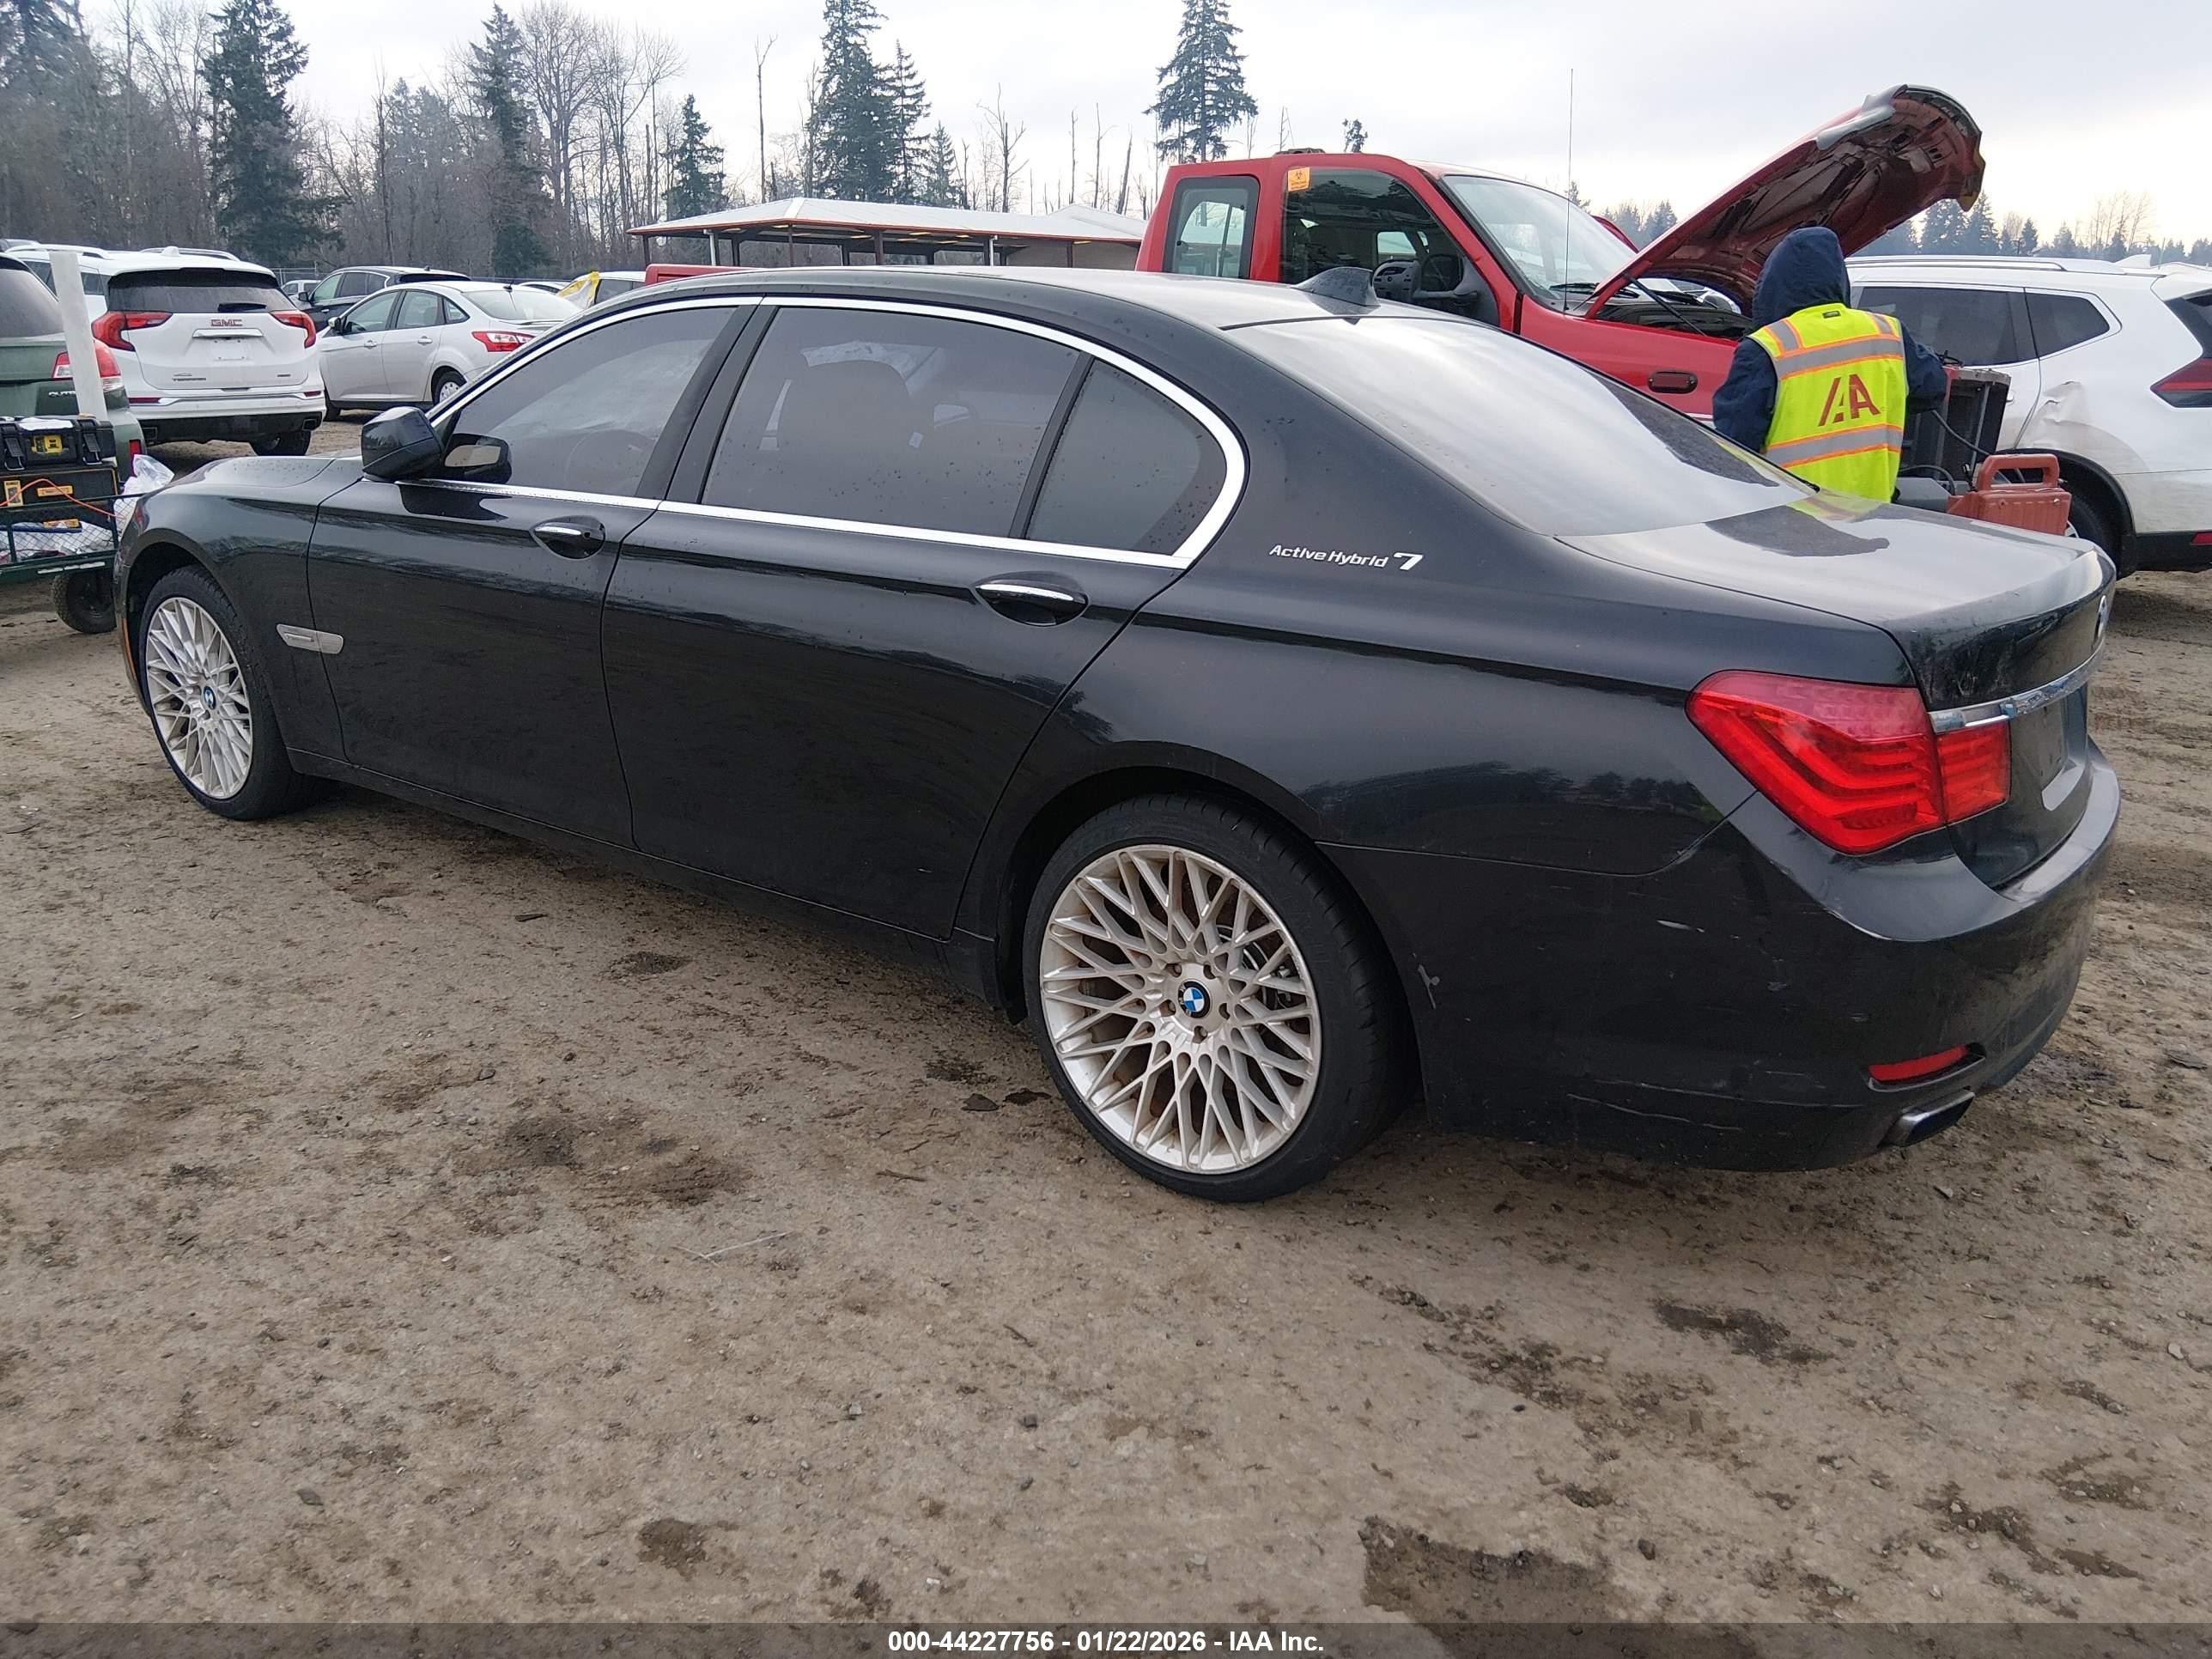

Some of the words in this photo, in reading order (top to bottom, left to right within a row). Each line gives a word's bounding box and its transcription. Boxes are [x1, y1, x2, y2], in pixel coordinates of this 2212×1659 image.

[210, 319, 243, 327] GMC
[1269, 544, 1327, 562] Active
[1328, 550, 1389, 568] Hybrid
[1393, 552, 1424, 571] 7
